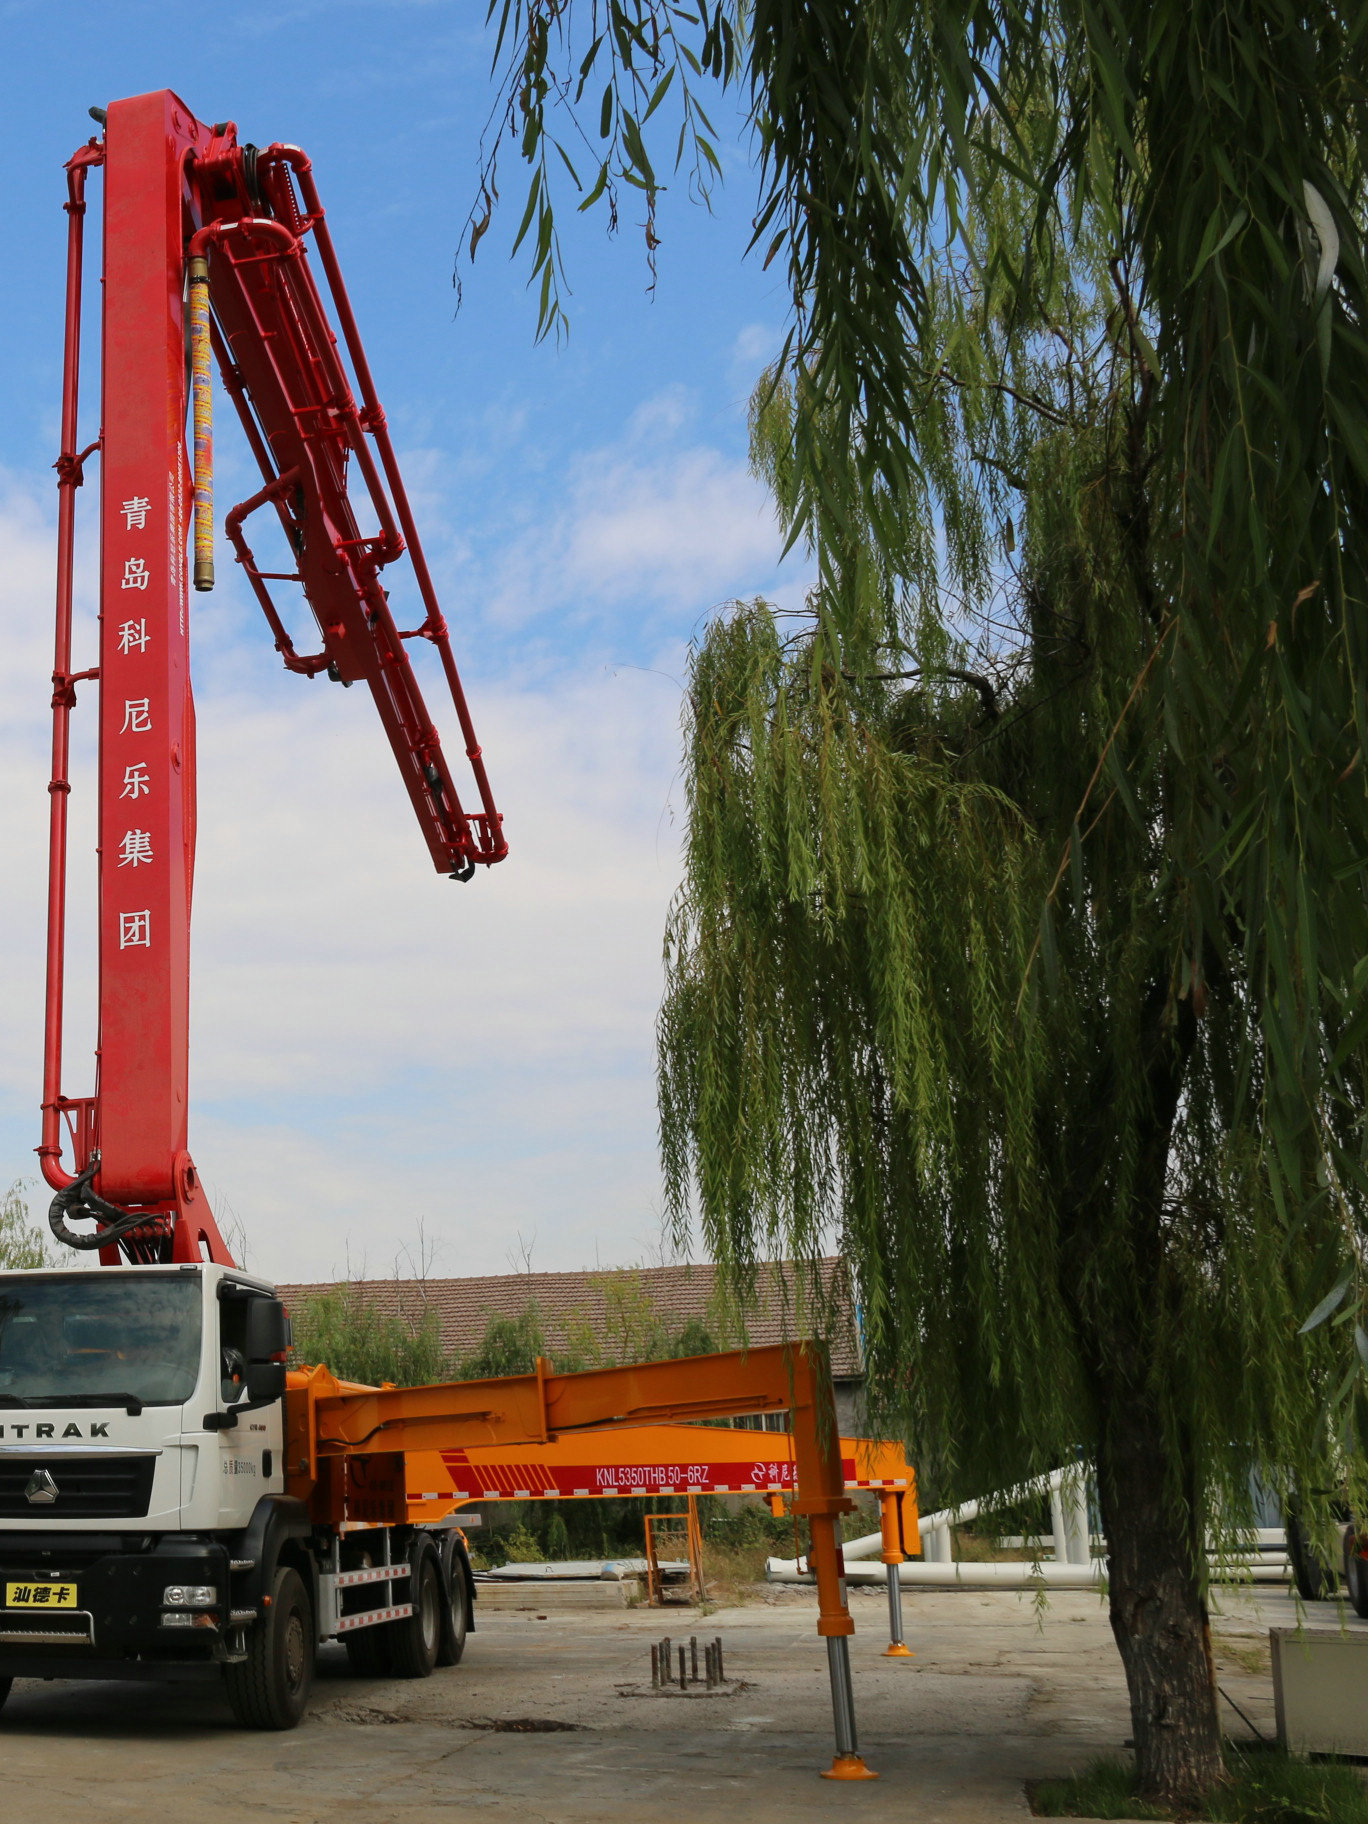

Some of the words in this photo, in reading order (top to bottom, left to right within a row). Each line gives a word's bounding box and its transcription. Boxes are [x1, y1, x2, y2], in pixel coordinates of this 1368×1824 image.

[117, 496, 153, 950] 青岛科尼乐集团
[596, 1466, 666, 1486] KNL5350THB
[668, 1465, 709, 1484] 50-6RZ
[12, 1586, 70, 1603] 汕德卡
